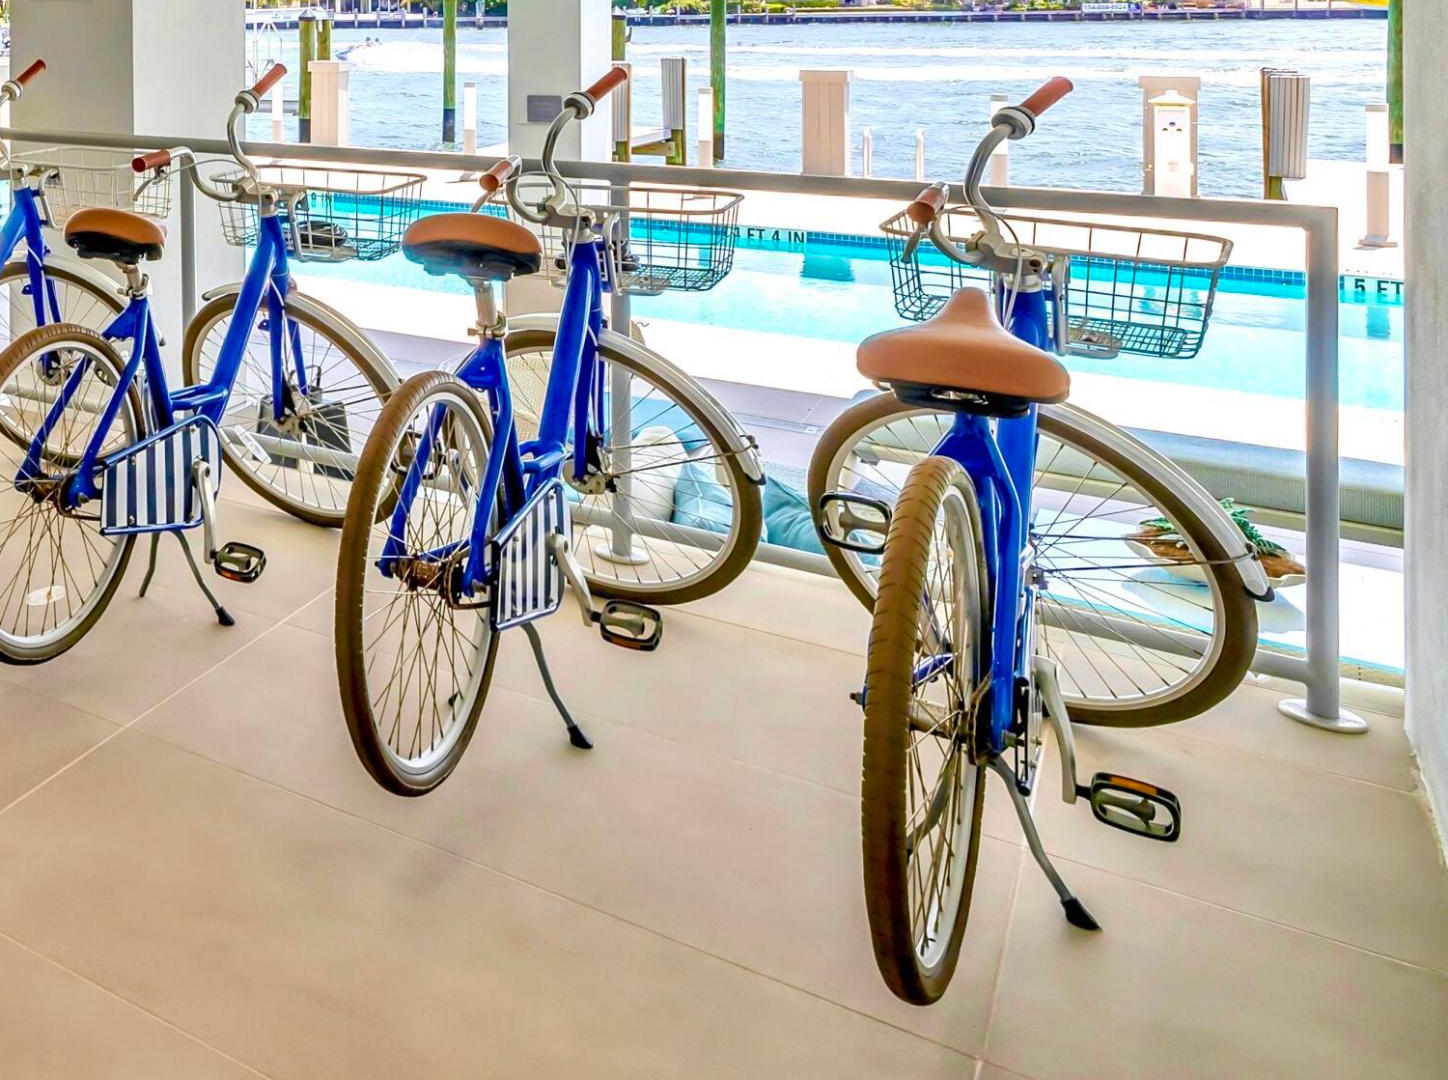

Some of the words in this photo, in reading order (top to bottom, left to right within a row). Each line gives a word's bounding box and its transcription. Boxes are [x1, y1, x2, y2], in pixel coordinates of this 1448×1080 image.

[747, 228, 766, 240] FT
[772, 230, 780, 241] 4
[788, 231, 804, 243] IN
[1354, 278, 1366, 293] 5
[1377, 280, 1404, 296] FT
